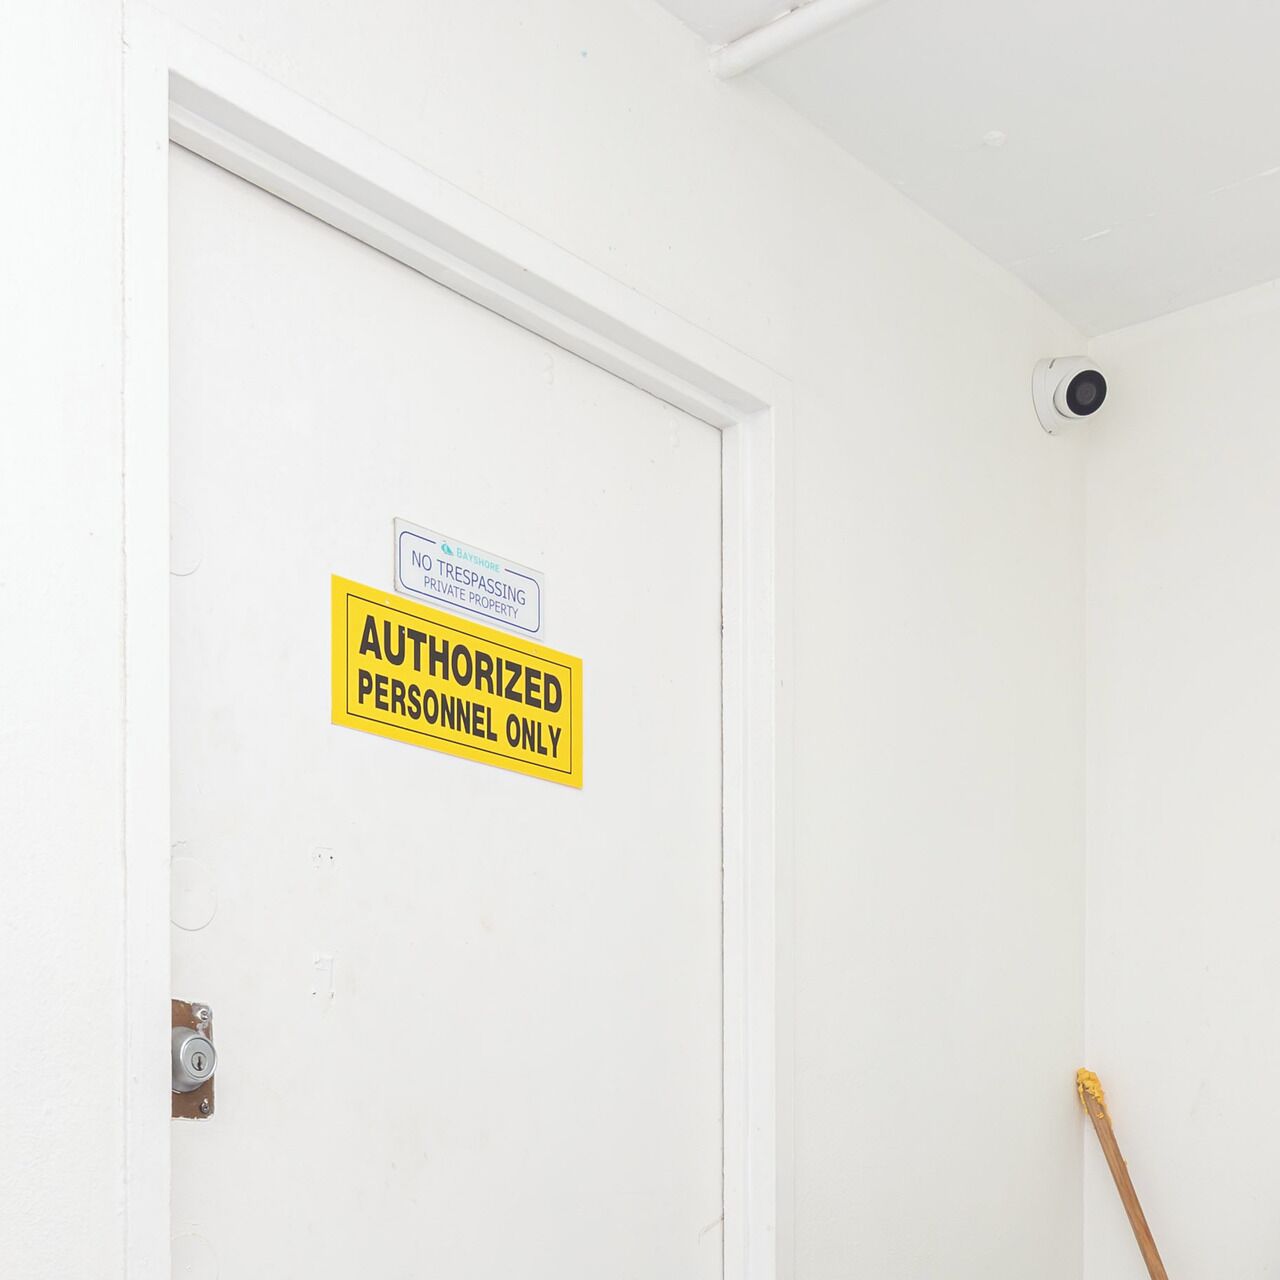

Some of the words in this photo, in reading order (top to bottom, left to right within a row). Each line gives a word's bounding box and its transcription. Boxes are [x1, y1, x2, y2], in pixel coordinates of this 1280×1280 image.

[412, 550, 432, 571] NO
[436, 558, 526, 606] TRESPASSING
[424, 575, 466, 601] PRIVATE
[469, 591, 519, 619] PROPERTY
[359, 614, 562, 713] AUTHORIZED
[358, 668, 497, 742] PERSONNEL
[506, 713, 561, 758] ONLY
